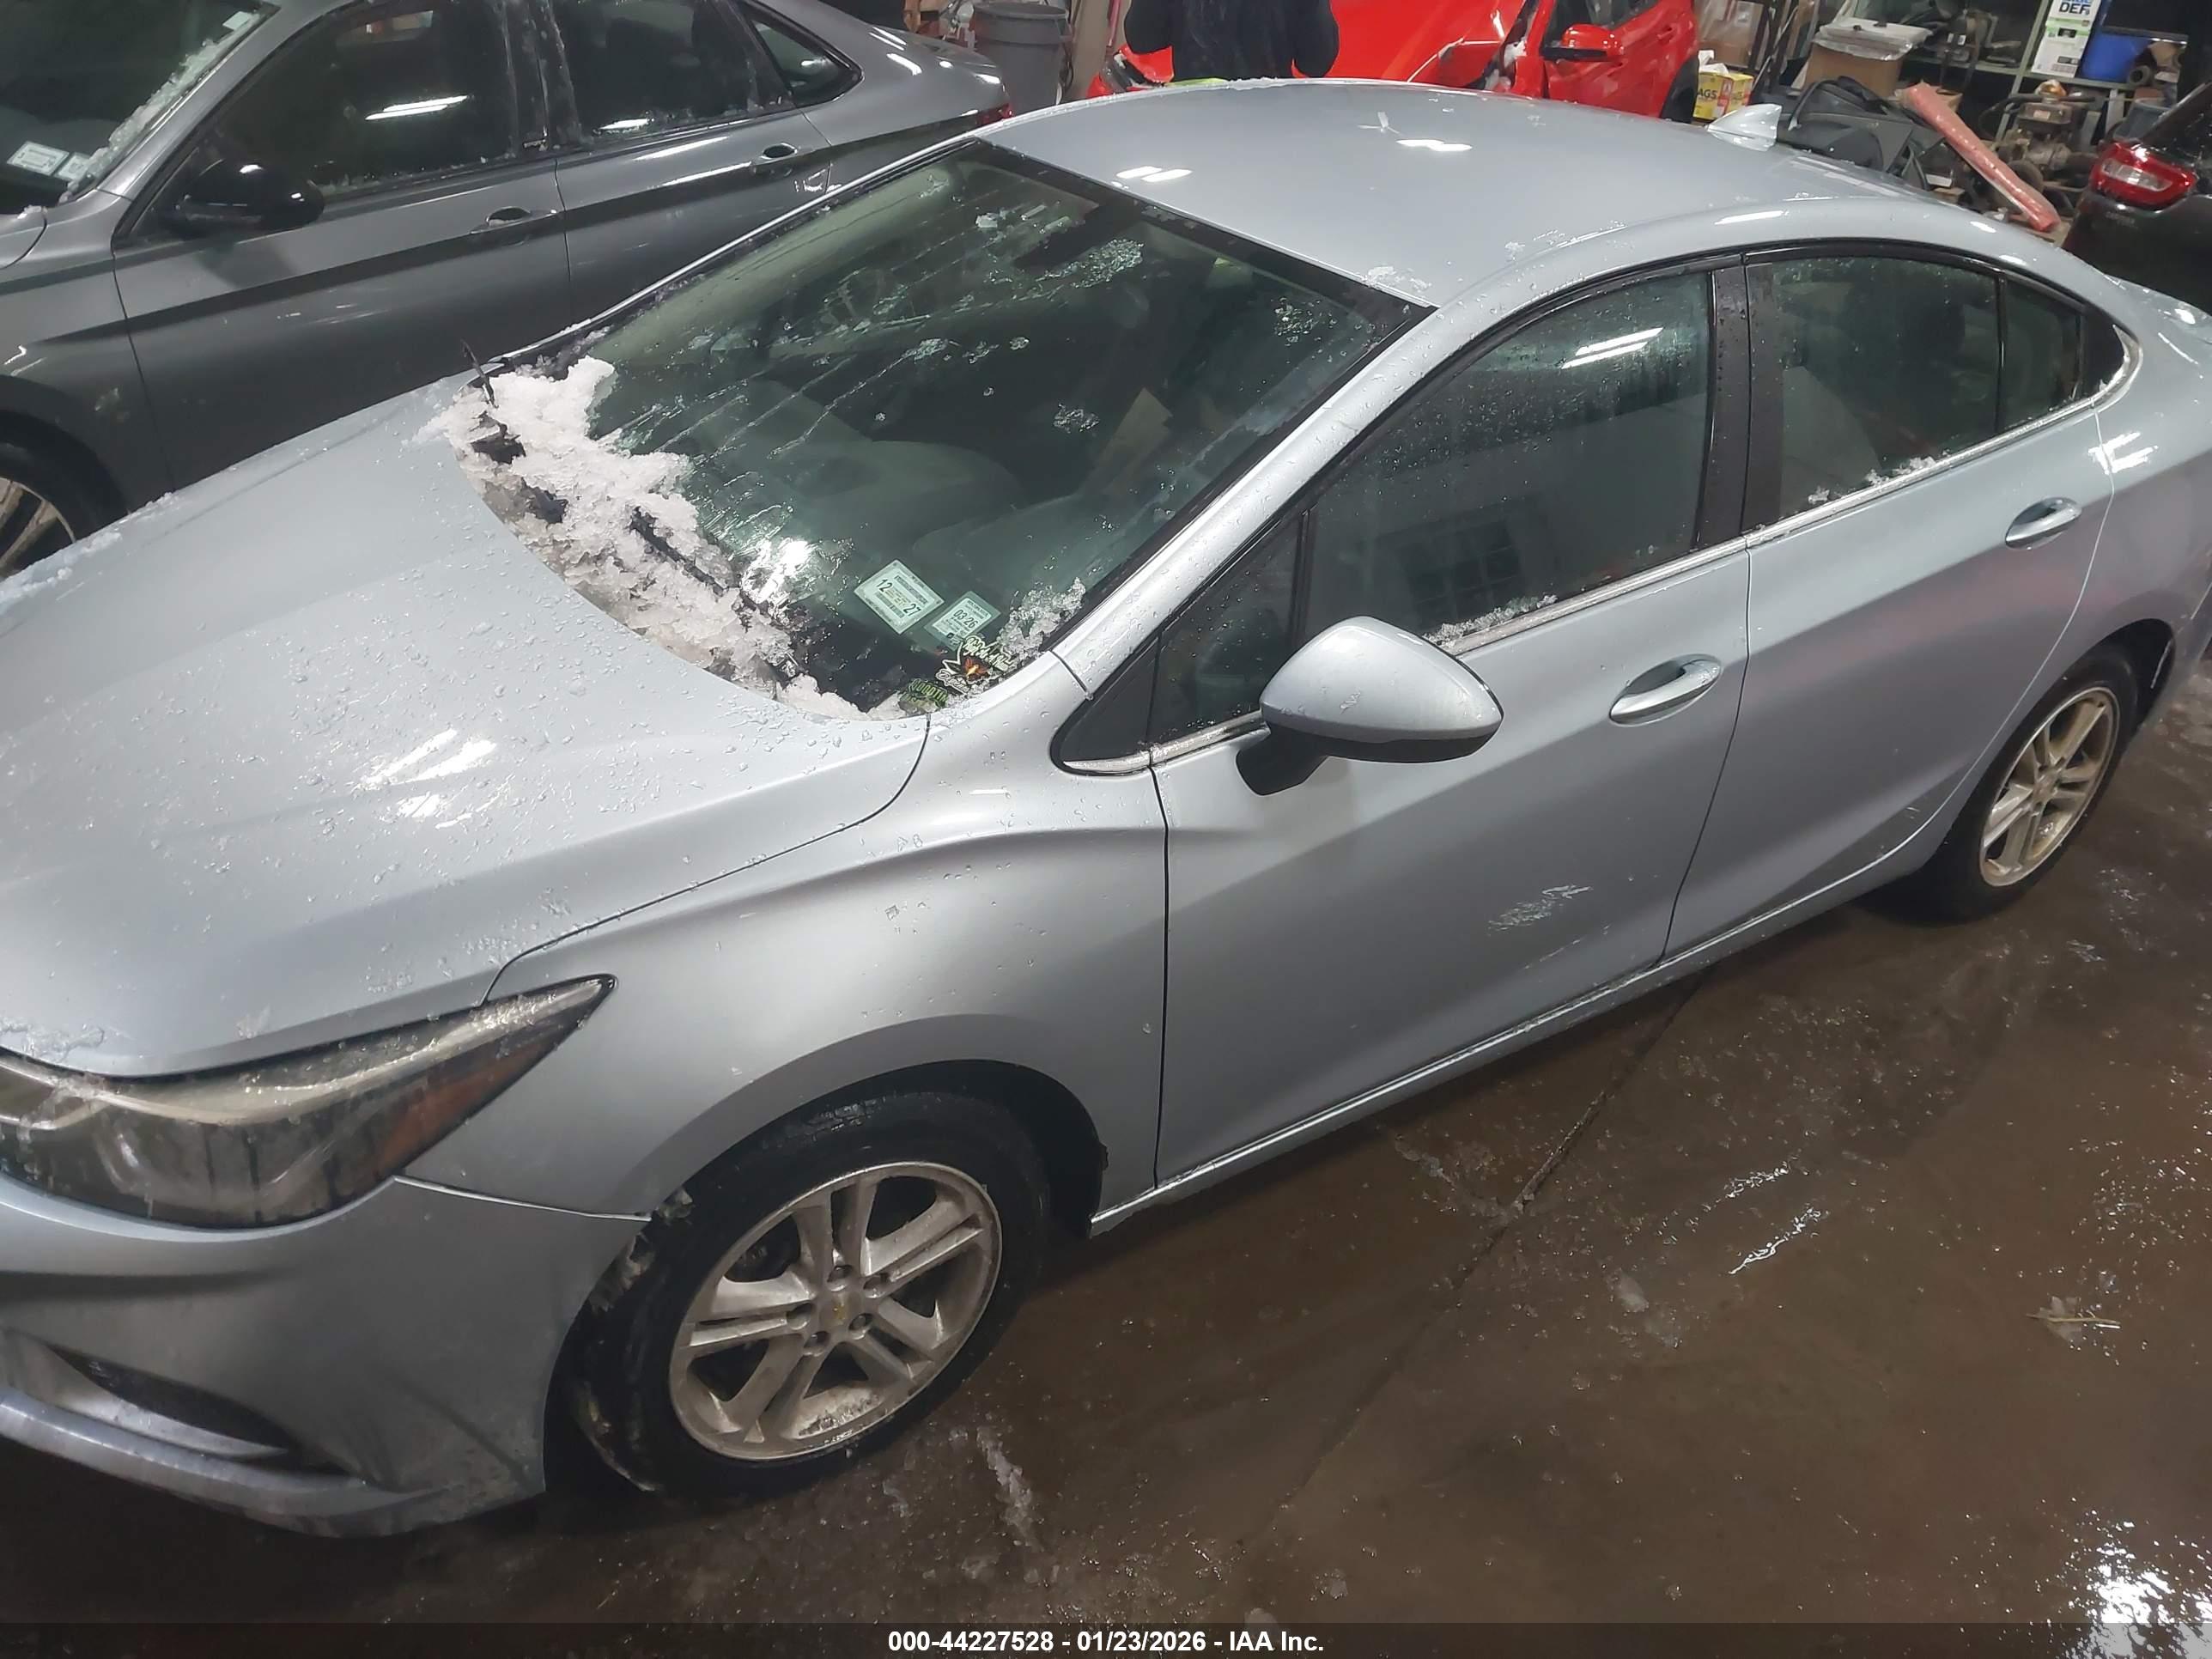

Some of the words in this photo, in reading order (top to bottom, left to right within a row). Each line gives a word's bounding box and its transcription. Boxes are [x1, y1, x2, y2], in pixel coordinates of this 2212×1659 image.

[2058, 2, 2091, 15] DEF
[877, 579, 893, 592] 12
[903, 603, 921, 617] 27
[953, 609, 968, 620] 03
[963, 617, 979, 629] 26
